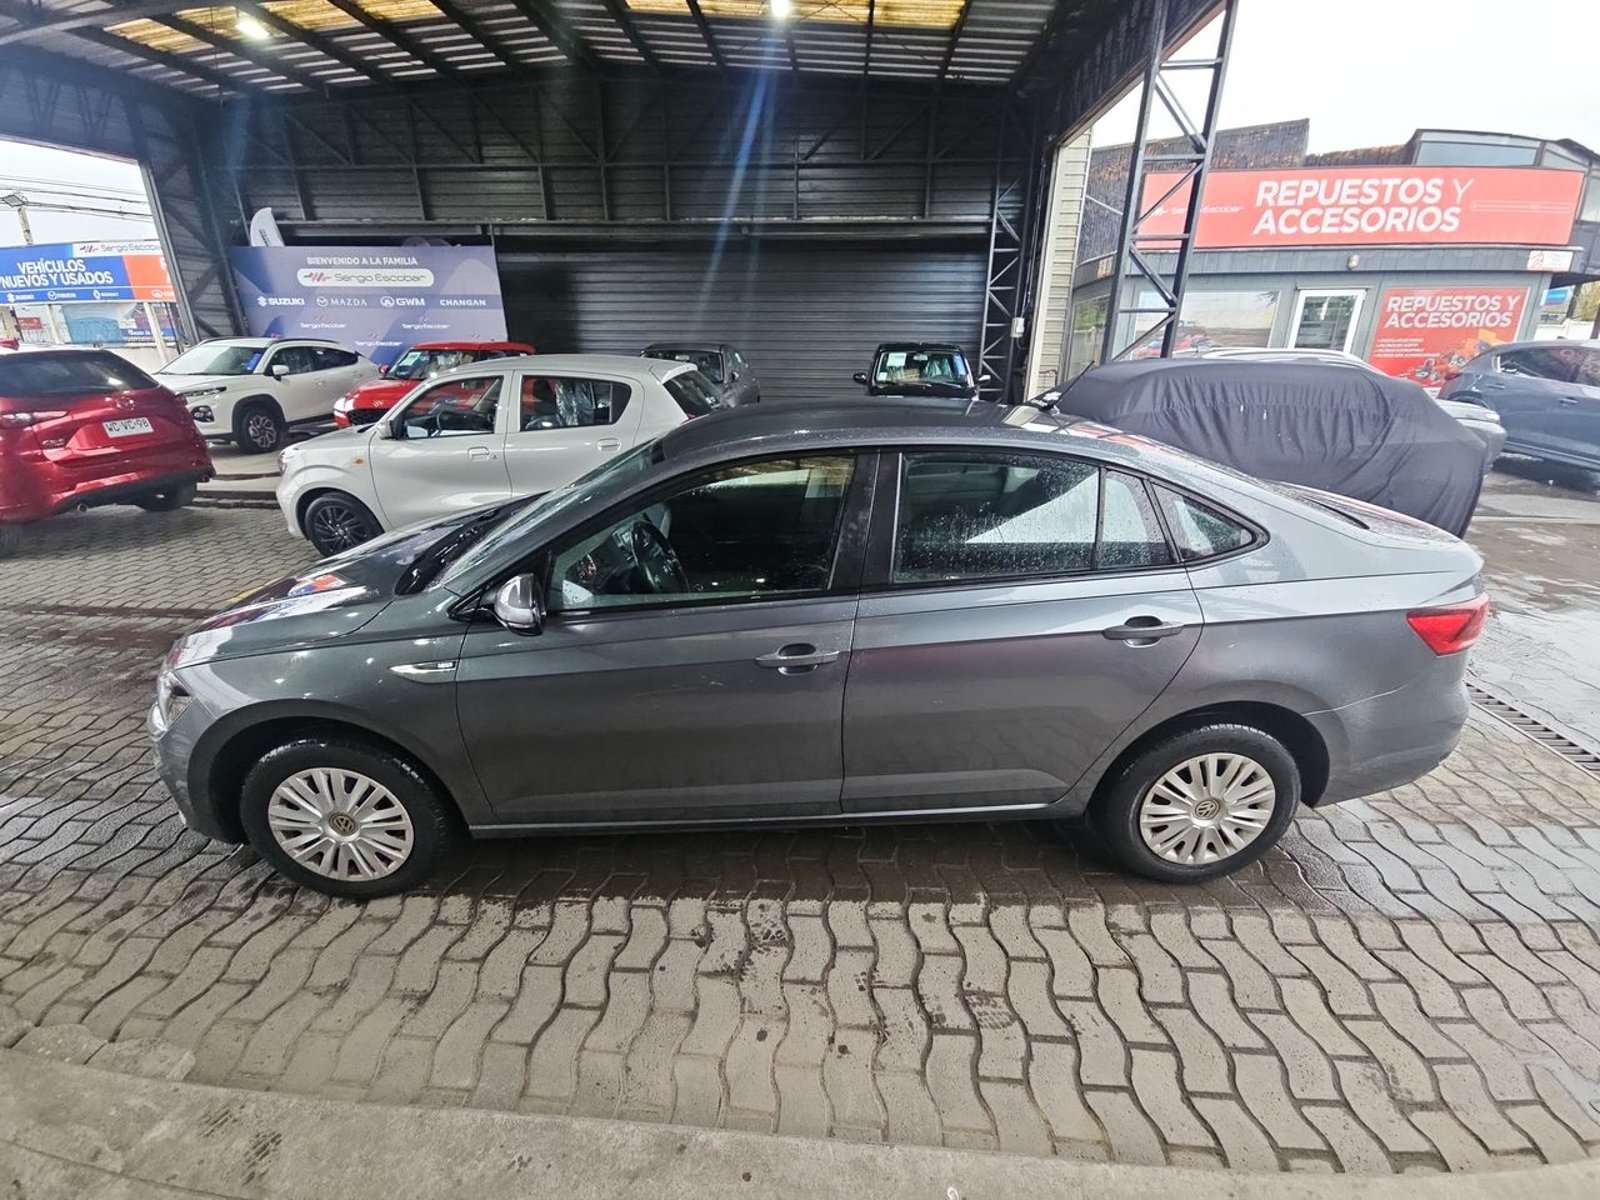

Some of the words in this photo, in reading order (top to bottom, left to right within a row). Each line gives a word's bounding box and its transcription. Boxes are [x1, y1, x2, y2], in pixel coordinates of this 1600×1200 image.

[1255, 178, 1444, 207] REPUESTOS
[1453, 178, 1475, 205] Y
[1252, 206, 1462, 235] ACCESORIOS
[17, 258, 87, 275] VEHÍCULOS
[306, 257, 360, 265] BIENVENIDO
[361, 257, 369, 265] A
[370, 257, 381, 265] LA
[383, 257, 418, 265] FAMILIA
[1, 273, 49, 289] NUEVOS
[49, 273, 58, 286] Y
[60, 271, 114, 286] USADOS
[374, 273, 426, 282] Escobar
[330, 297, 367, 306] MAZDA
[396, 298, 425, 306] GWM
[1386, 295, 1502, 312] REPUESTOS
[1507, 295, 1520, 310] Y
[1384, 311, 1513, 328] ACCESORIOS
